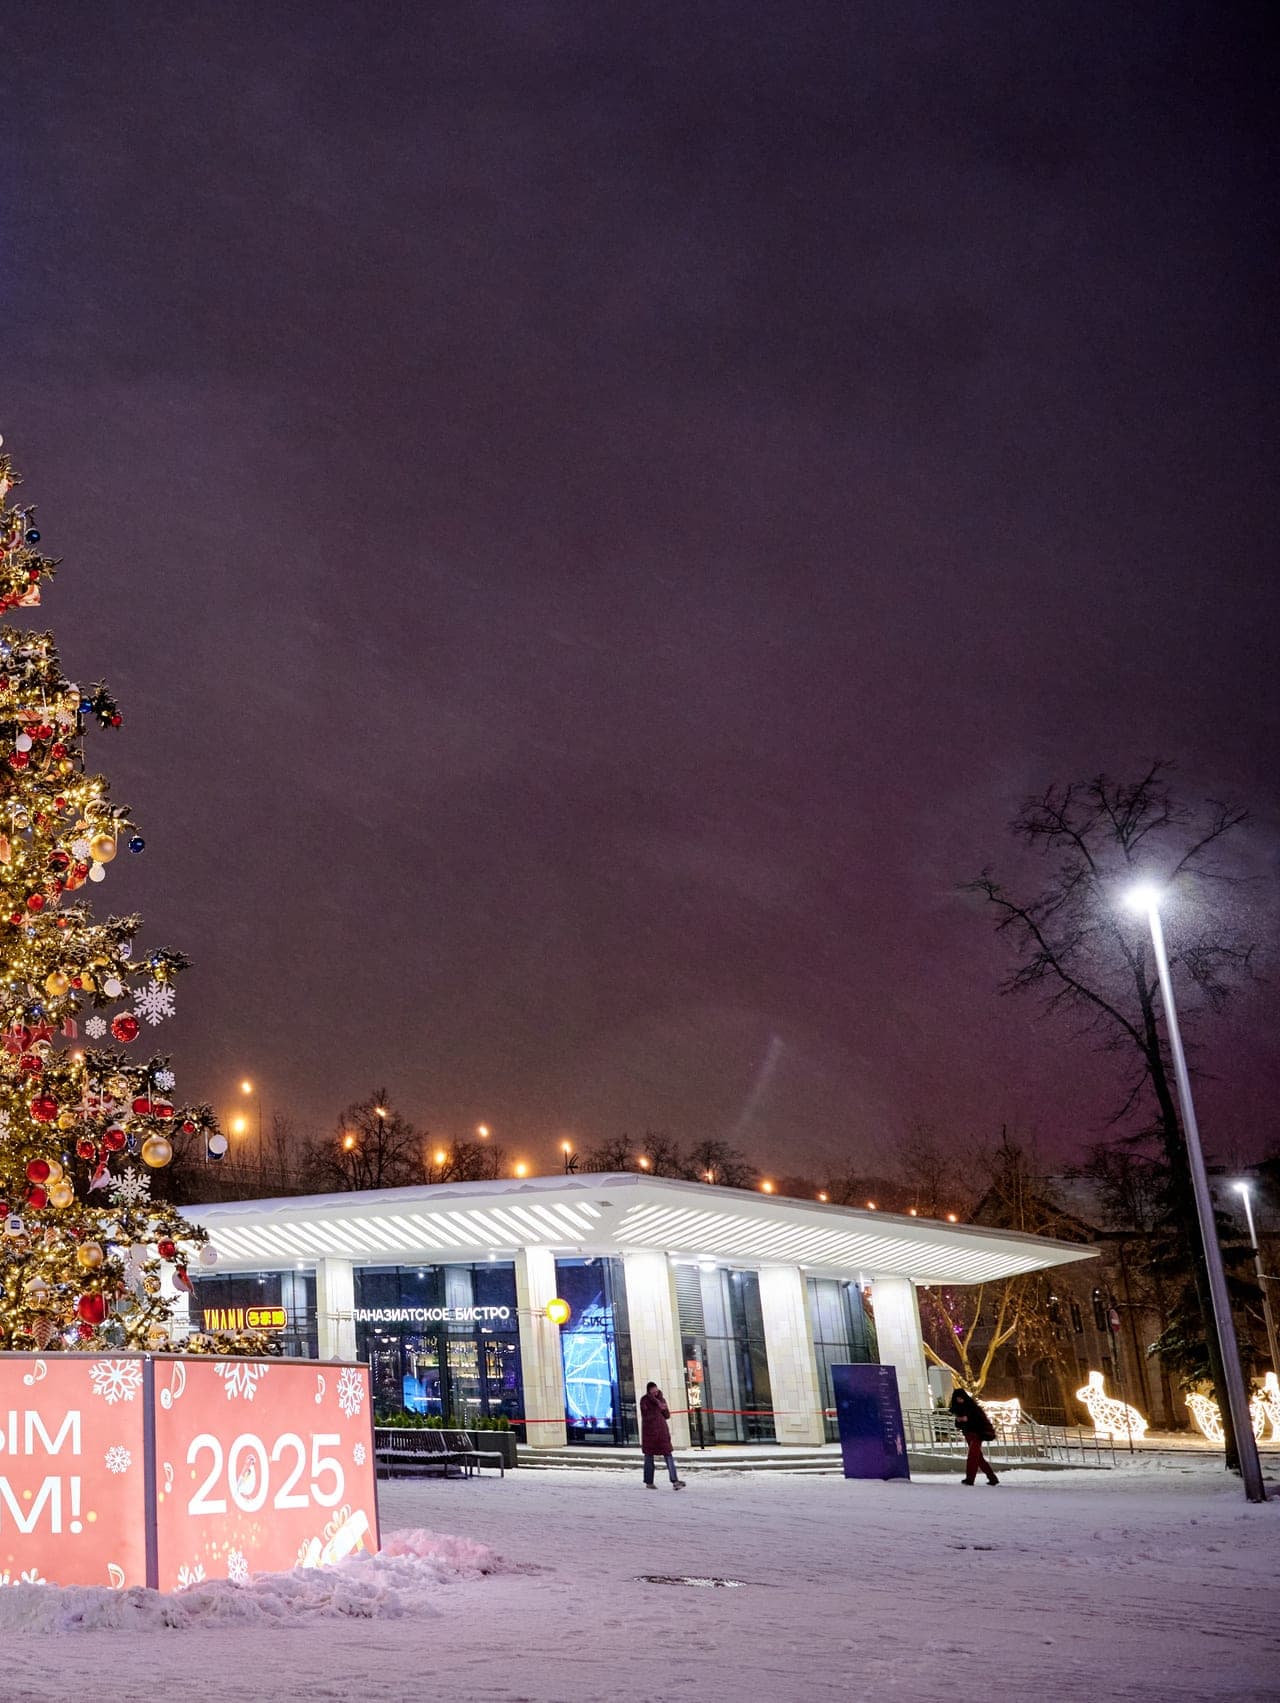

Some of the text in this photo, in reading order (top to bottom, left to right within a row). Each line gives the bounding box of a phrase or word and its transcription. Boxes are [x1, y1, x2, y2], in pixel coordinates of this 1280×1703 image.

[352, 1306, 510, 1322] ПАНАЗИАТСКОЕ БИСТРО
[186, 1432, 345, 1516] 2025
